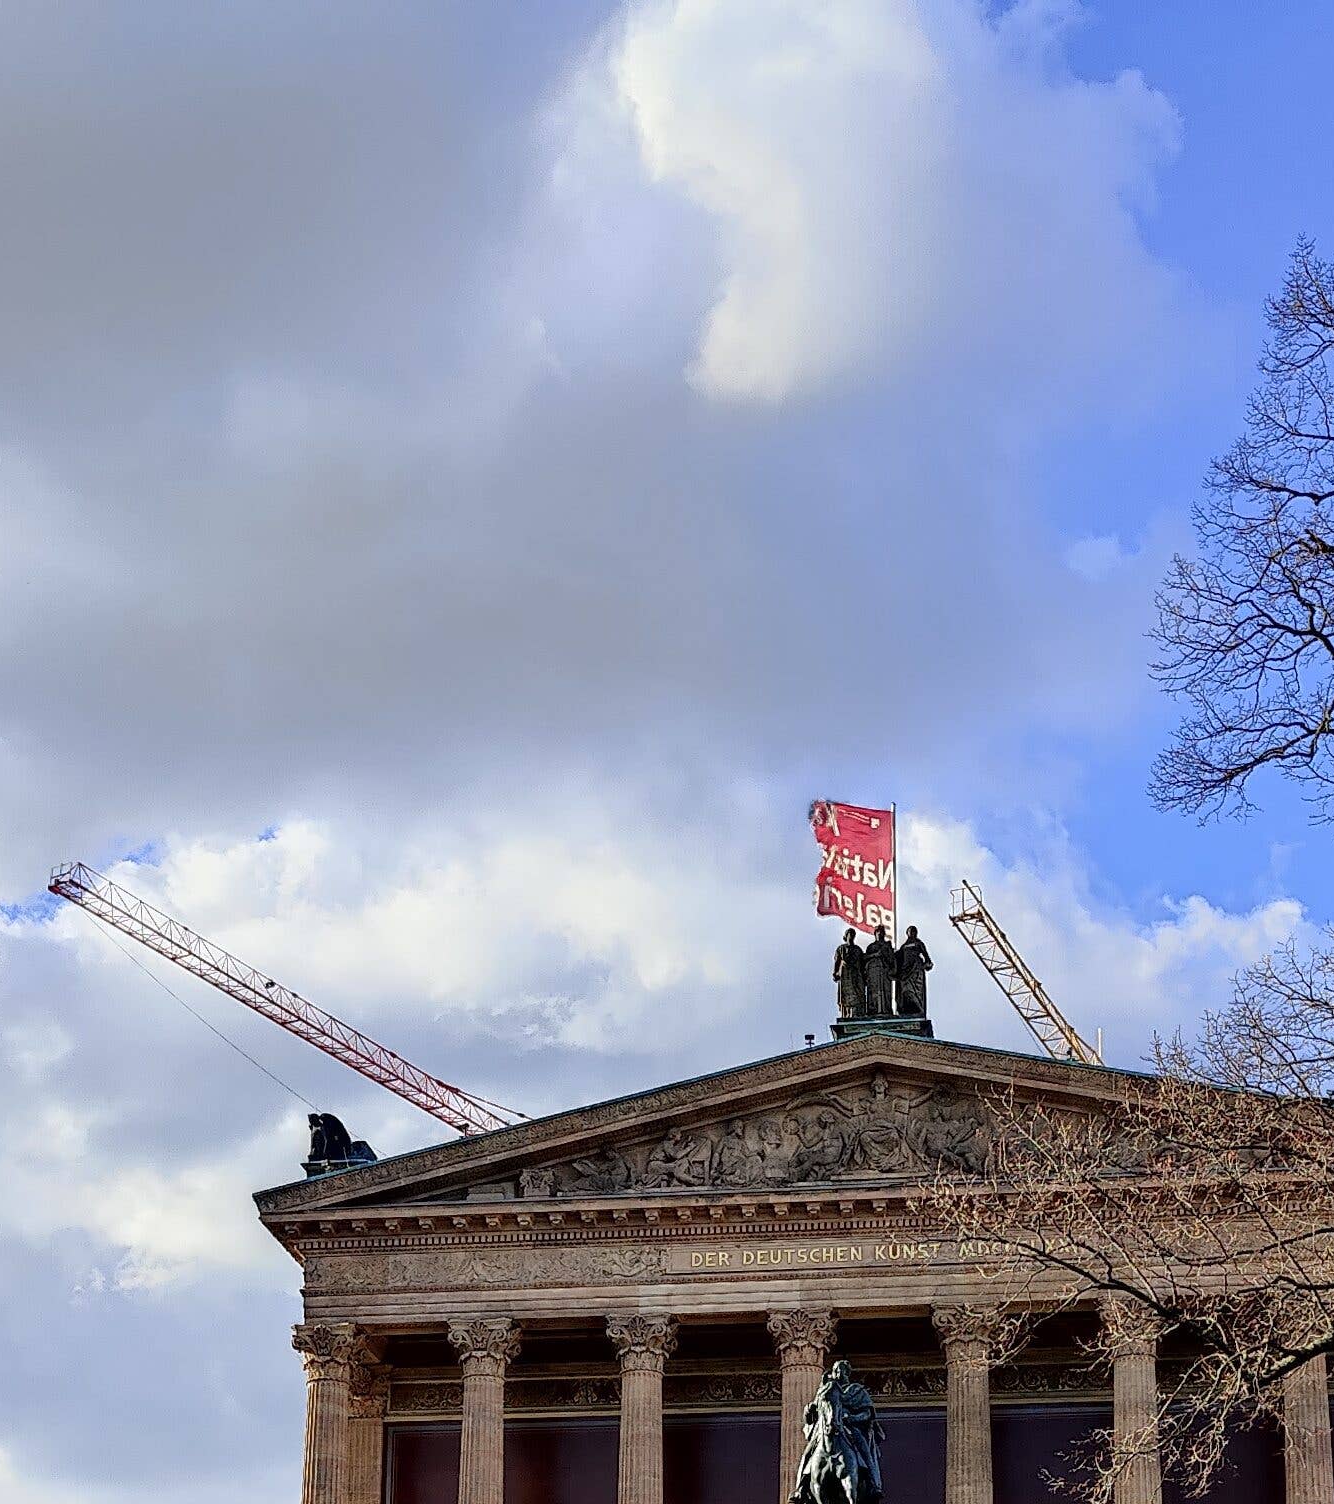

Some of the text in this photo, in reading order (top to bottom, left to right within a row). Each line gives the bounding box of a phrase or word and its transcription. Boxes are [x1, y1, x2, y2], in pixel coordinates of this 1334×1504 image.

[691, 1251, 730, 1267] DER
[742, 1246, 863, 1265] DEUTSCHEN
[875, 1242, 941, 1260] KUNST
